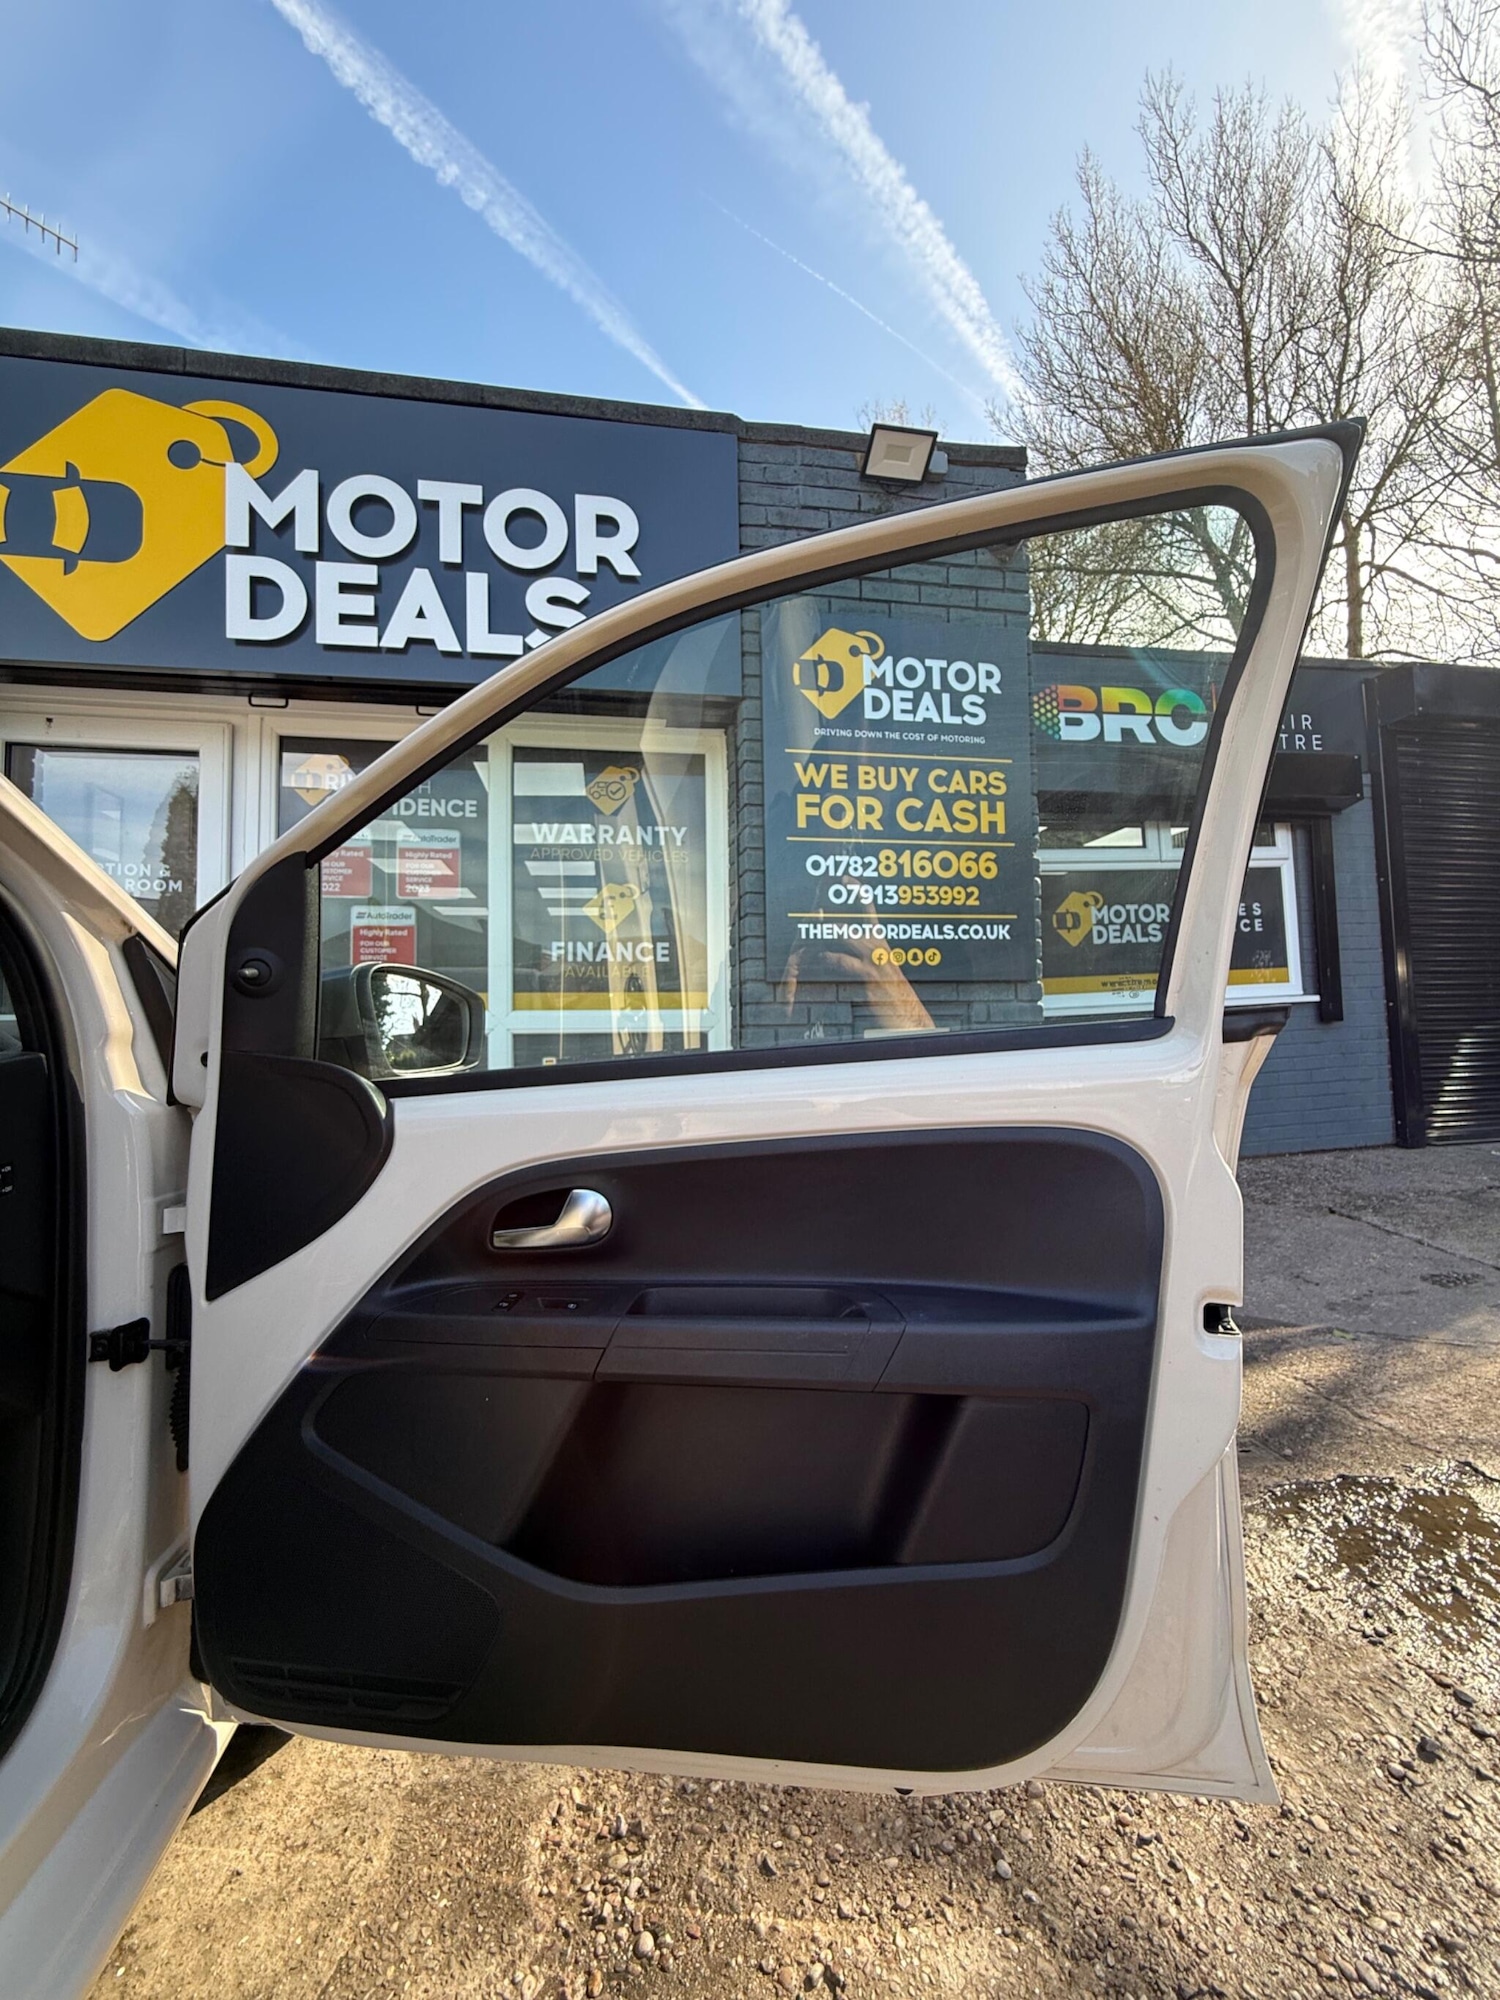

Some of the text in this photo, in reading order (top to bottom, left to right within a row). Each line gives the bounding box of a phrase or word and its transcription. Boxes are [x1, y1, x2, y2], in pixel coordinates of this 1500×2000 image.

[225, 461, 641, 577] MOTOR
[225, 554, 591, 656] DEALS
[862, 653, 1002, 695] MOTOR
[863, 687, 987, 726] DEALS
[1057, 684, 1208, 747] BRC
[1280, 713, 1313, 731] IR
[813, 727, 986, 744] DRIVING DOWN THE COST OF MOTORING
[1279, 733, 1323, 751] TRE
[794, 762, 1007, 796] WE BUY CARS
[391, 797, 478, 818] IDENCE
[796, 794, 1006, 835] FOR CASH
[531, 822, 688, 847] WARRANTY
[405, 850, 453, 860] Highly Rated
[530, 847, 689, 863] APPROVED VEHICLES
[805, 848, 999, 880] 01782816066
[160, 862, 171, 877] &
[125, 878, 183, 893] ROOM
[321, 882, 341, 892] 022
[828, 884, 980, 907] 07913953992
[366, 911, 413, 920] AutoTrader
[1091, 903, 1171, 925] MOTOR
[1239, 902, 1262, 917] ES
[360, 928, 409, 937] Highly Rated
[797, 923, 1012, 941] THEMOTORDEALS.CO.UK
[1092, 923, 1163, 945] DEALS
[1239, 918, 1264, 933] CE
[551, 940, 671, 963] FINANCE
[564, 965, 650, 979] AVAILABLE
